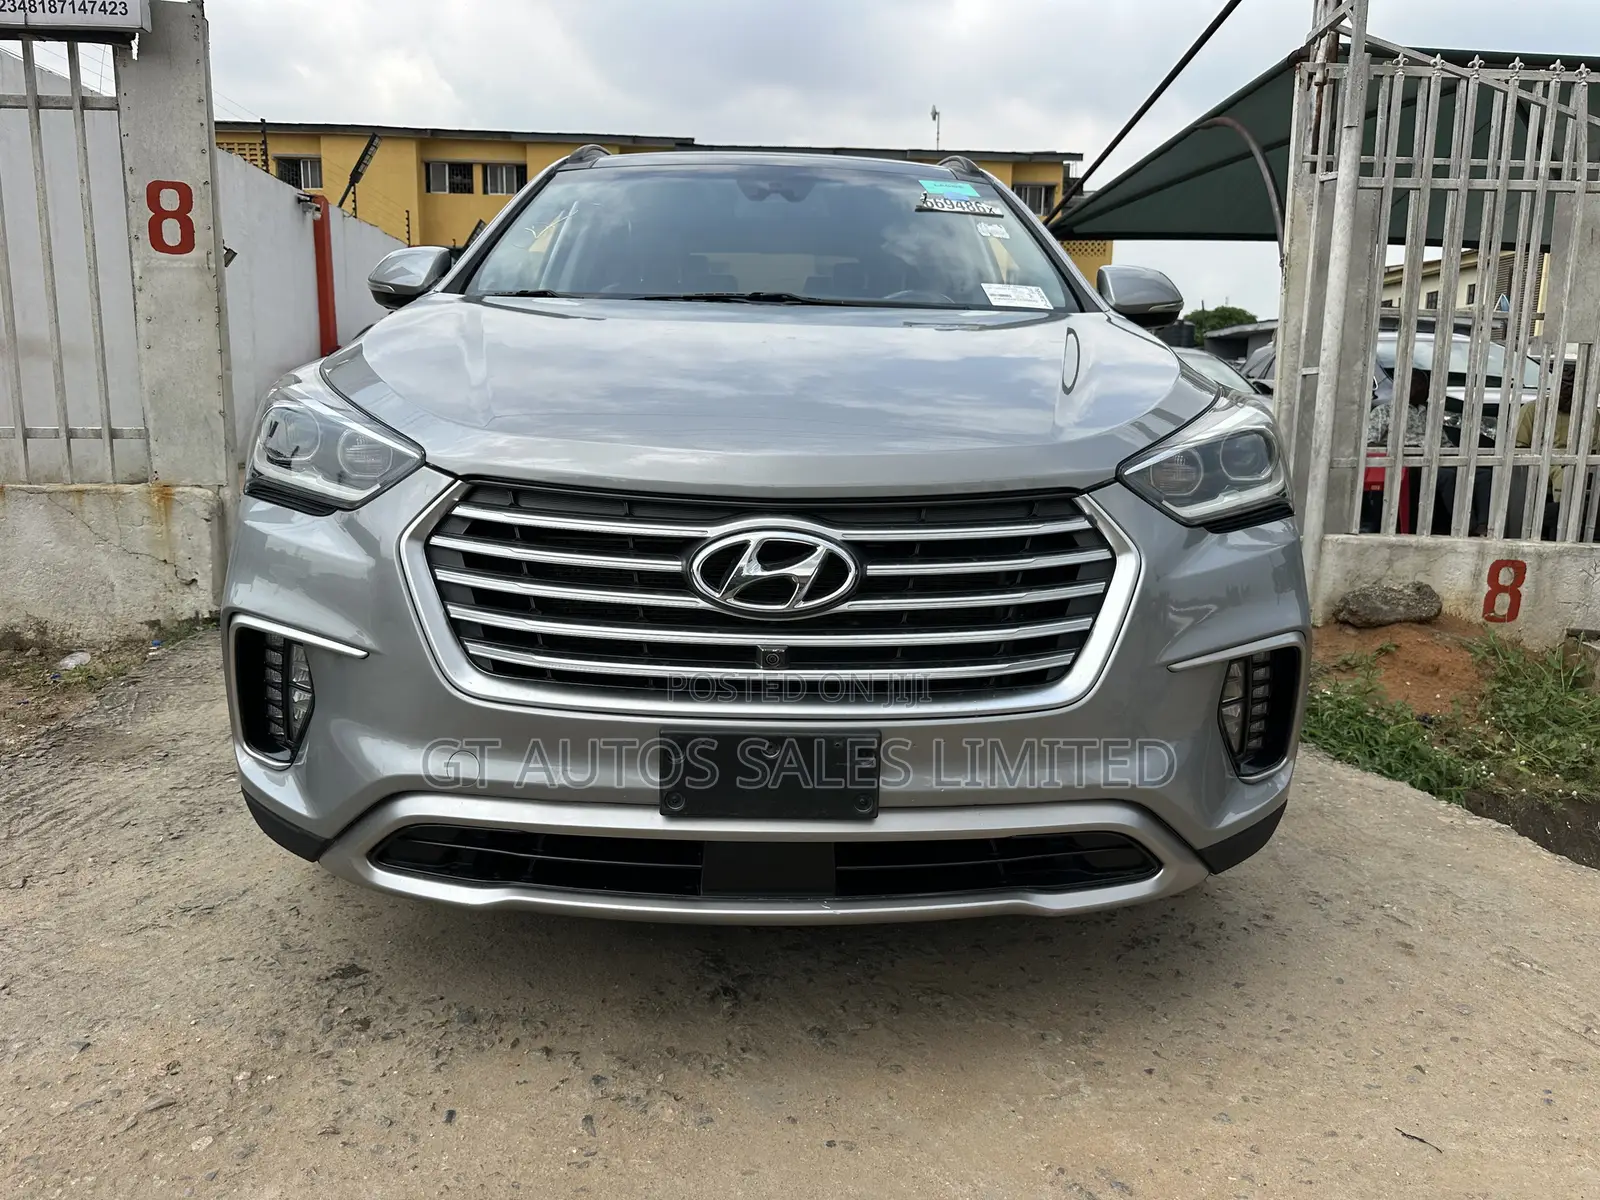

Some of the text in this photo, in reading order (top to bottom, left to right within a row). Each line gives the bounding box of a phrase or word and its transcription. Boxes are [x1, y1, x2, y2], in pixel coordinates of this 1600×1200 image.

[0, 0, 128, 15] 2348187147423
[146, 180, 196, 255] 8
[1482, 559, 1527, 623] 8
